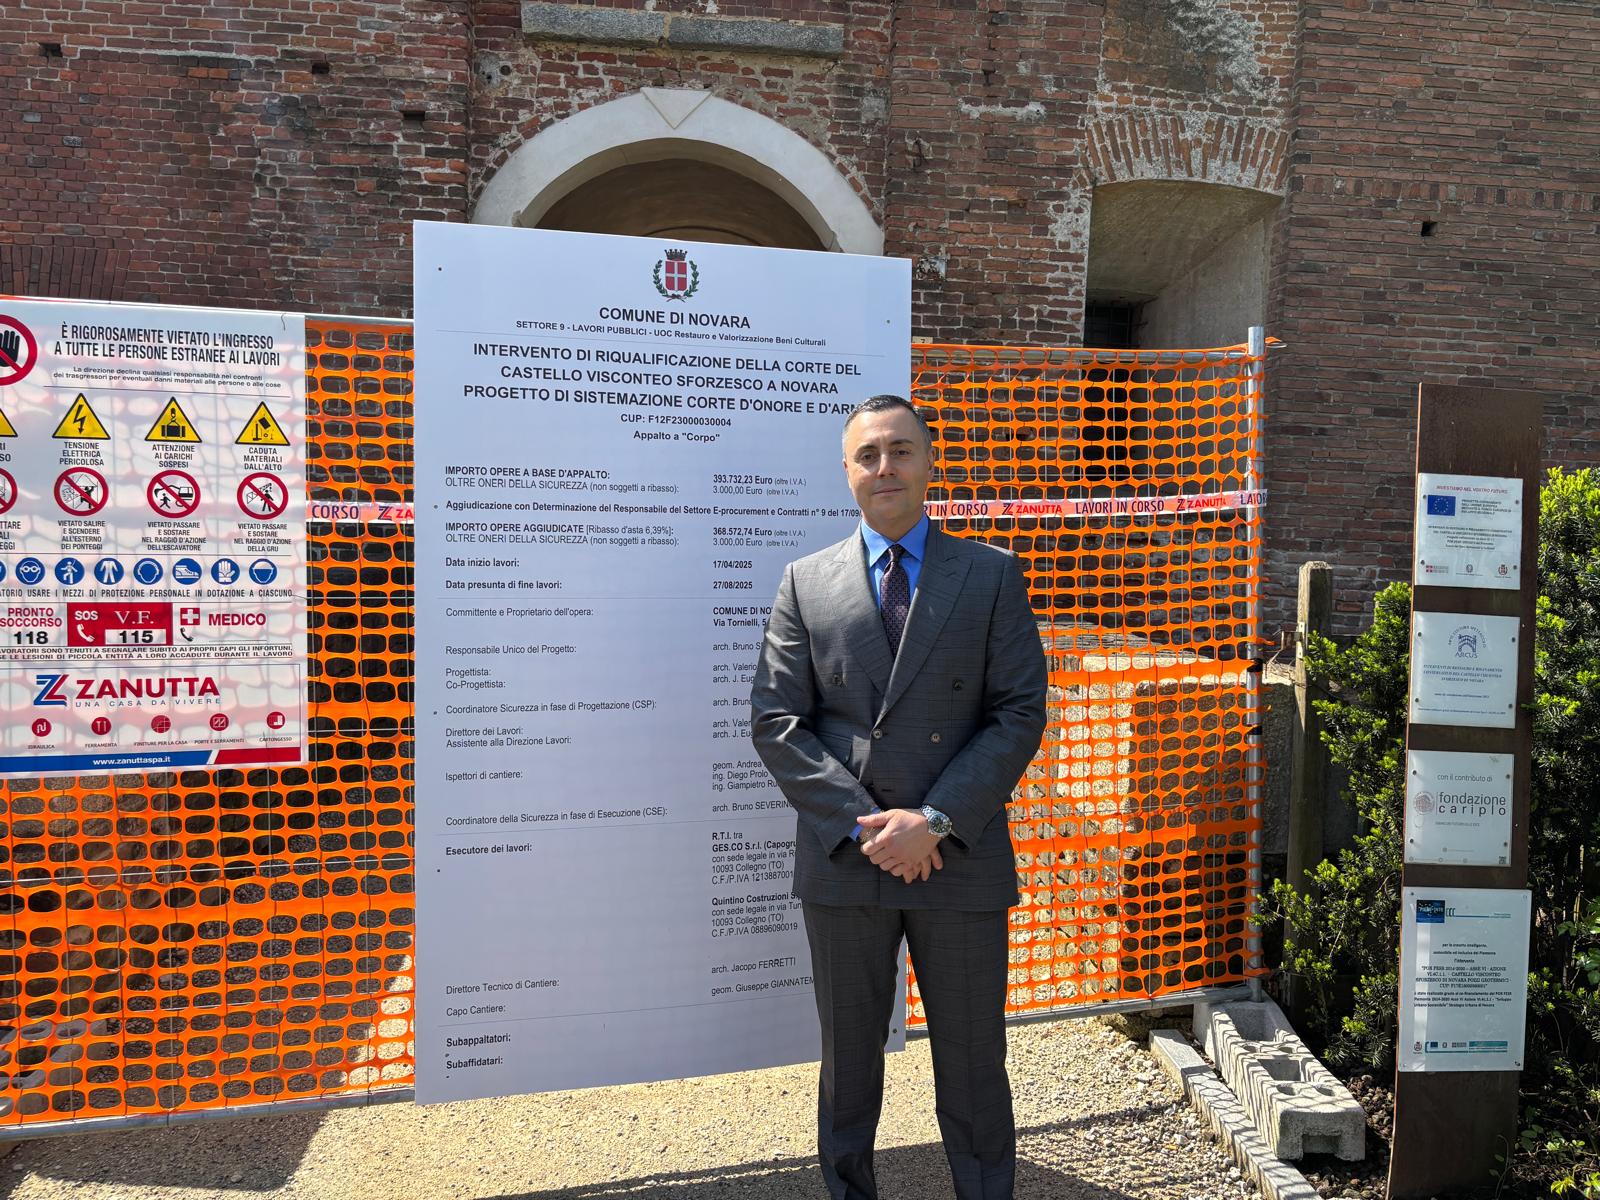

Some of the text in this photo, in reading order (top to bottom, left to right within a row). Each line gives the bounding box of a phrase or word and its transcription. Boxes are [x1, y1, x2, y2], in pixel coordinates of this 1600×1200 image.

[600, 307, 750, 328] COMUNE DI NOVARA
[62, 322, 274, 349] È RIGOROSAMENTE VIETATO L'INGRESSO
[516, 320, 557, 330] SETTORE
[560, 322, 565, 331] 9
[572, 323, 605, 333] LAVORI
[607, 325, 647, 336] PUBBLICI
[654, 328, 672, 337] UOC
[674, 329, 710, 339] Restauro
[719, 331, 774, 343] Valorizzazione
[776, 334, 792, 344] Beni
[794, 336, 826, 346] Culturali
[54, 342, 280, 366] A TUTTE LE PERSONE ESTRANEE AI LAVORI
[474, 343, 861, 375] INTERVENTO DI RIQUALIFICAZIONE DELLA CORTE DEL
[501, 365, 838, 393] CASTELLO VISCONTEO SFORZESCO A NOVARA
[464, 384, 550, 400] PROGETTO
[555, 388, 569, 401] DI
[574, 389, 682, 406] SISTEMAZIONE
[687, 394, 735, 408] CORTE
[740, 397, 803, 412] D'ONORE
[806, 400, 815, 412] E
[621, 413, 732, 426] CUP: F12F23000030004
[634, 430, 671, 443] Appalto
[682, 432, 720, 444] "Corpo"
[64, 441, 99, 449] TENSIONE
[152, 444, 195, 452] ATTENZIONE
[249, 447, 278, 455] CADUTA
[62, 450, 101, 458] ELETTRICA
[164, 452, 192, 460] CARICHI
[244, 455, 282, 463] MATERIALI
[59, 457, 104, 466] PERICOLOSA
[159, 460, 189, 468] SOSPESI
[244, 462, 282, 471] DALL'ALTO
[446, 466, 610, 479] IMPORTO OPERE A BASE D'APPALTO:
[714, 475, 806, 487] 393.732,23 Euro (oltre I.V.A.)
[312, 505, 358, 519] CORSO
[936, 505, 947, 516] IN
[951, 504, 988, 516] CORSO
[1016, 504, 1062, 514] ZANUTTA
[1075, 502, 1112, 514] LAVORI
[1116, 502, 1127, 513] IN
[1132, 500, 1164, 512] CORSO
[446, 557, 520, 567] Data inizio lavori:
[713, 560, 752, 568] 17/04/2025
[446, 580, 562, 590] Data presunta di fine lavori:
[713, 581, 753, 589] 27/08/2025
[8, 608, 54, 616] PRONTO
[75, 610, 98, 620] SOS
[114, 610, 154, 624] V.F.
[0, 618, 62, 627] SOCCORSO
[208, 614, 266, 626] MEDICO
[14, 632, 48, 644] 118
[119, 631, 153, 644] 115
[446, 667, 491, 678] Progettista:
[76, 677, 220, 699] ZANUTTA
[446, 679, 506, 690] Co-Progettista:
[93, 756, 171, 766] www.zanuttaspa.it
[1439, 792, 1506, 805] fondazione
[1439, 805, 1506, 816] cariplo
[446, 842, 532, 855] Esecutore dei lavori:
[712, 922, 798, 937] C.F./P.IVA 08896090019
[712, 956, 796, 973] arch. Jacopo FERRETTI
[446, 979, 559, 994] Direttore Tecnico di Cantiere:
[446, 1033, 511, 1047] Subappaltatori:
[446, 1055, 503, 1069] Subaffidatari:
